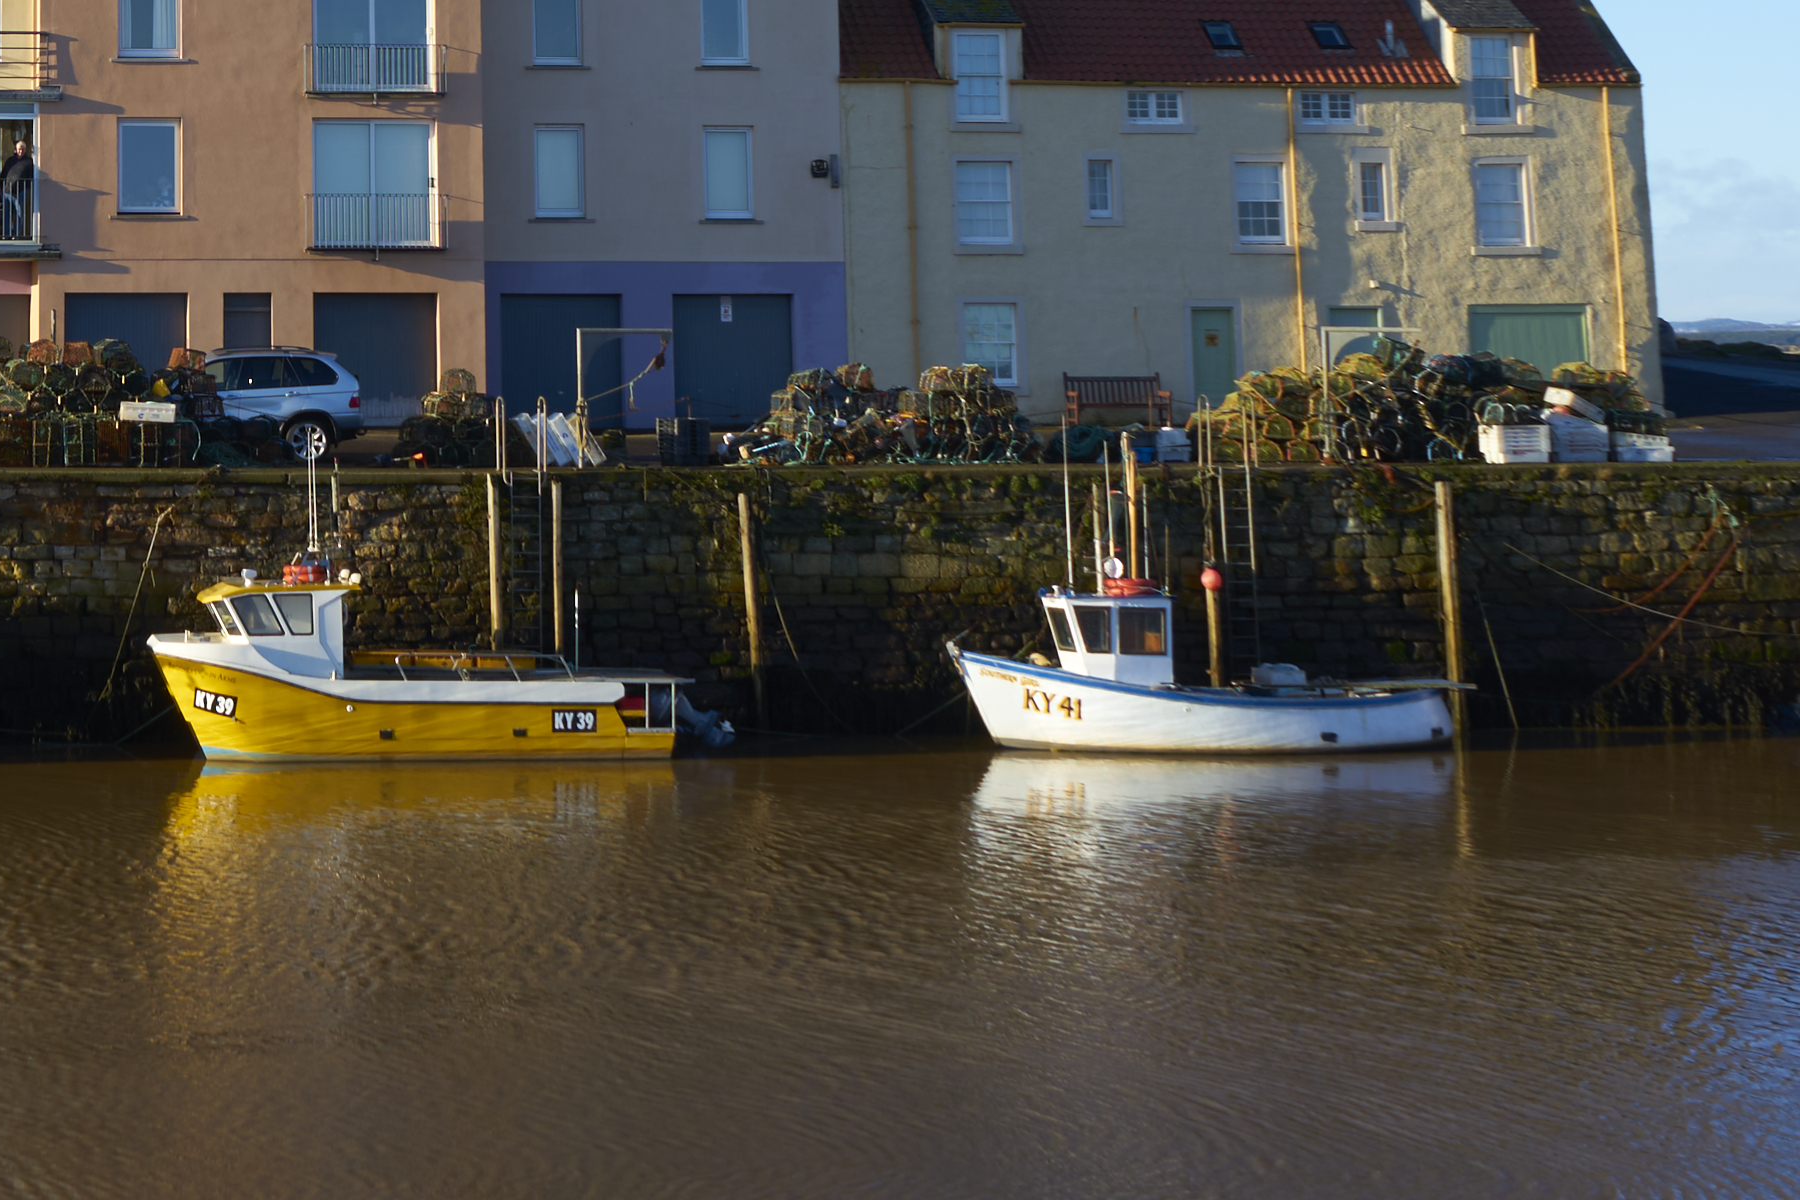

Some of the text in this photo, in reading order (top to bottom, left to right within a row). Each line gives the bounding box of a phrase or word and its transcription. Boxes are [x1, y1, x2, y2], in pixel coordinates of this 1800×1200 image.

[195, 689, 234, 715] KY 39
[1022, 688, 1083, 721] KY 41
[554, 712, 594, 730] KY 39
